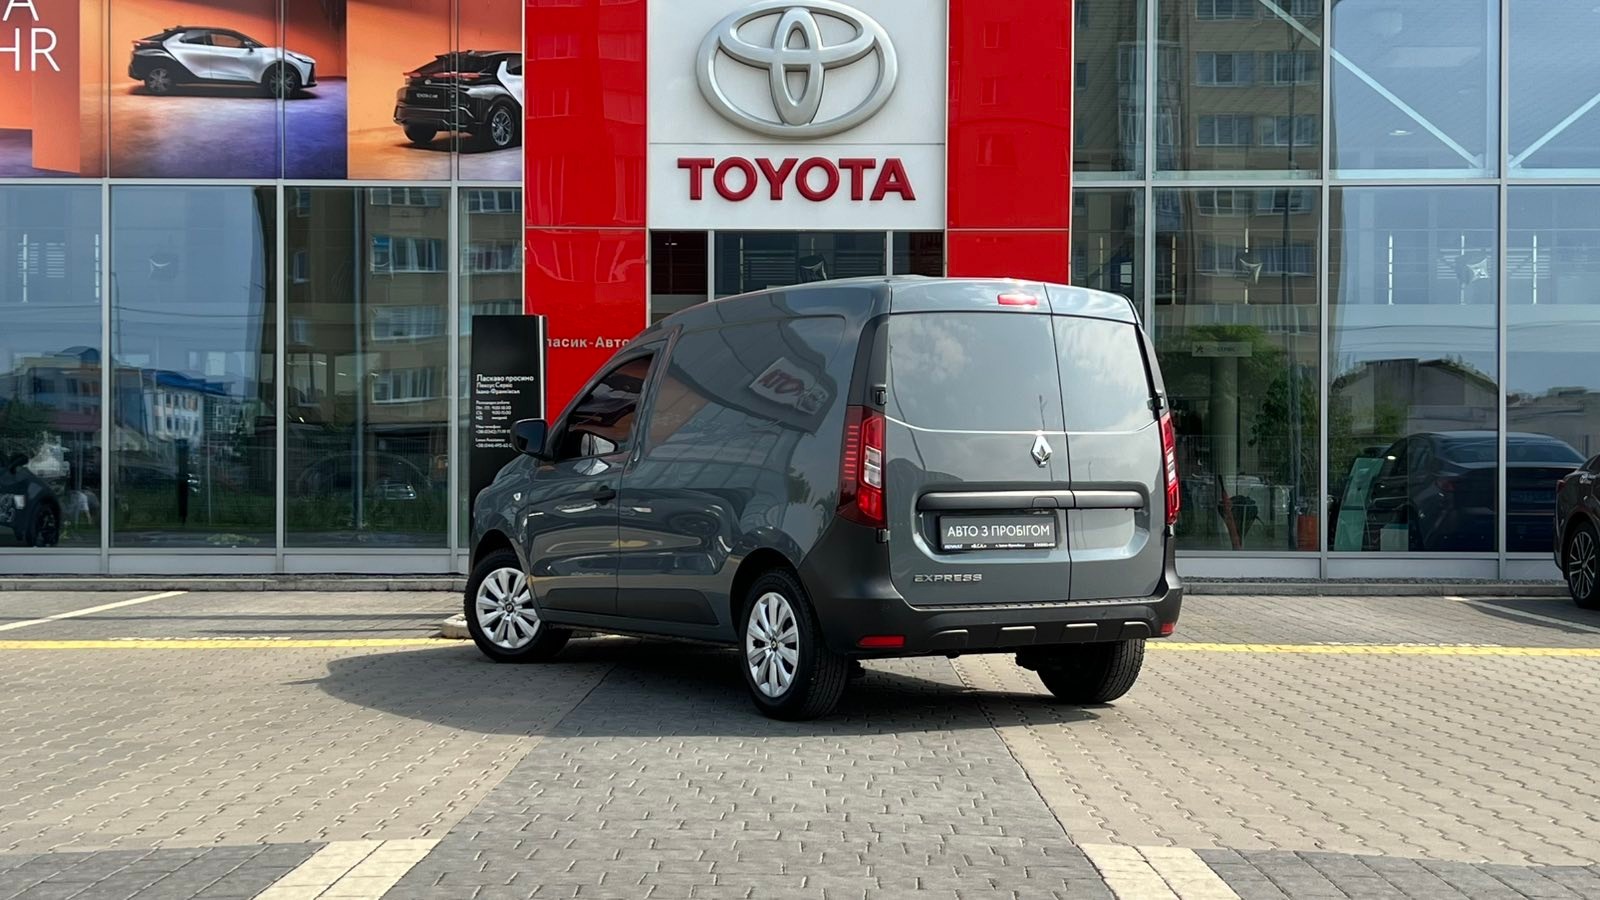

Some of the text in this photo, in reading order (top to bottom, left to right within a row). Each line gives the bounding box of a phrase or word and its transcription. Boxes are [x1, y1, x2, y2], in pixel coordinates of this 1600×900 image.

[677, 156, 916, 202] TOYOTA
[947, 526, 979, 537] АВТО
[991, 524, 1050, 537] ПРОБІГОМ
[914, 573, 983, 583] EXPRESS
